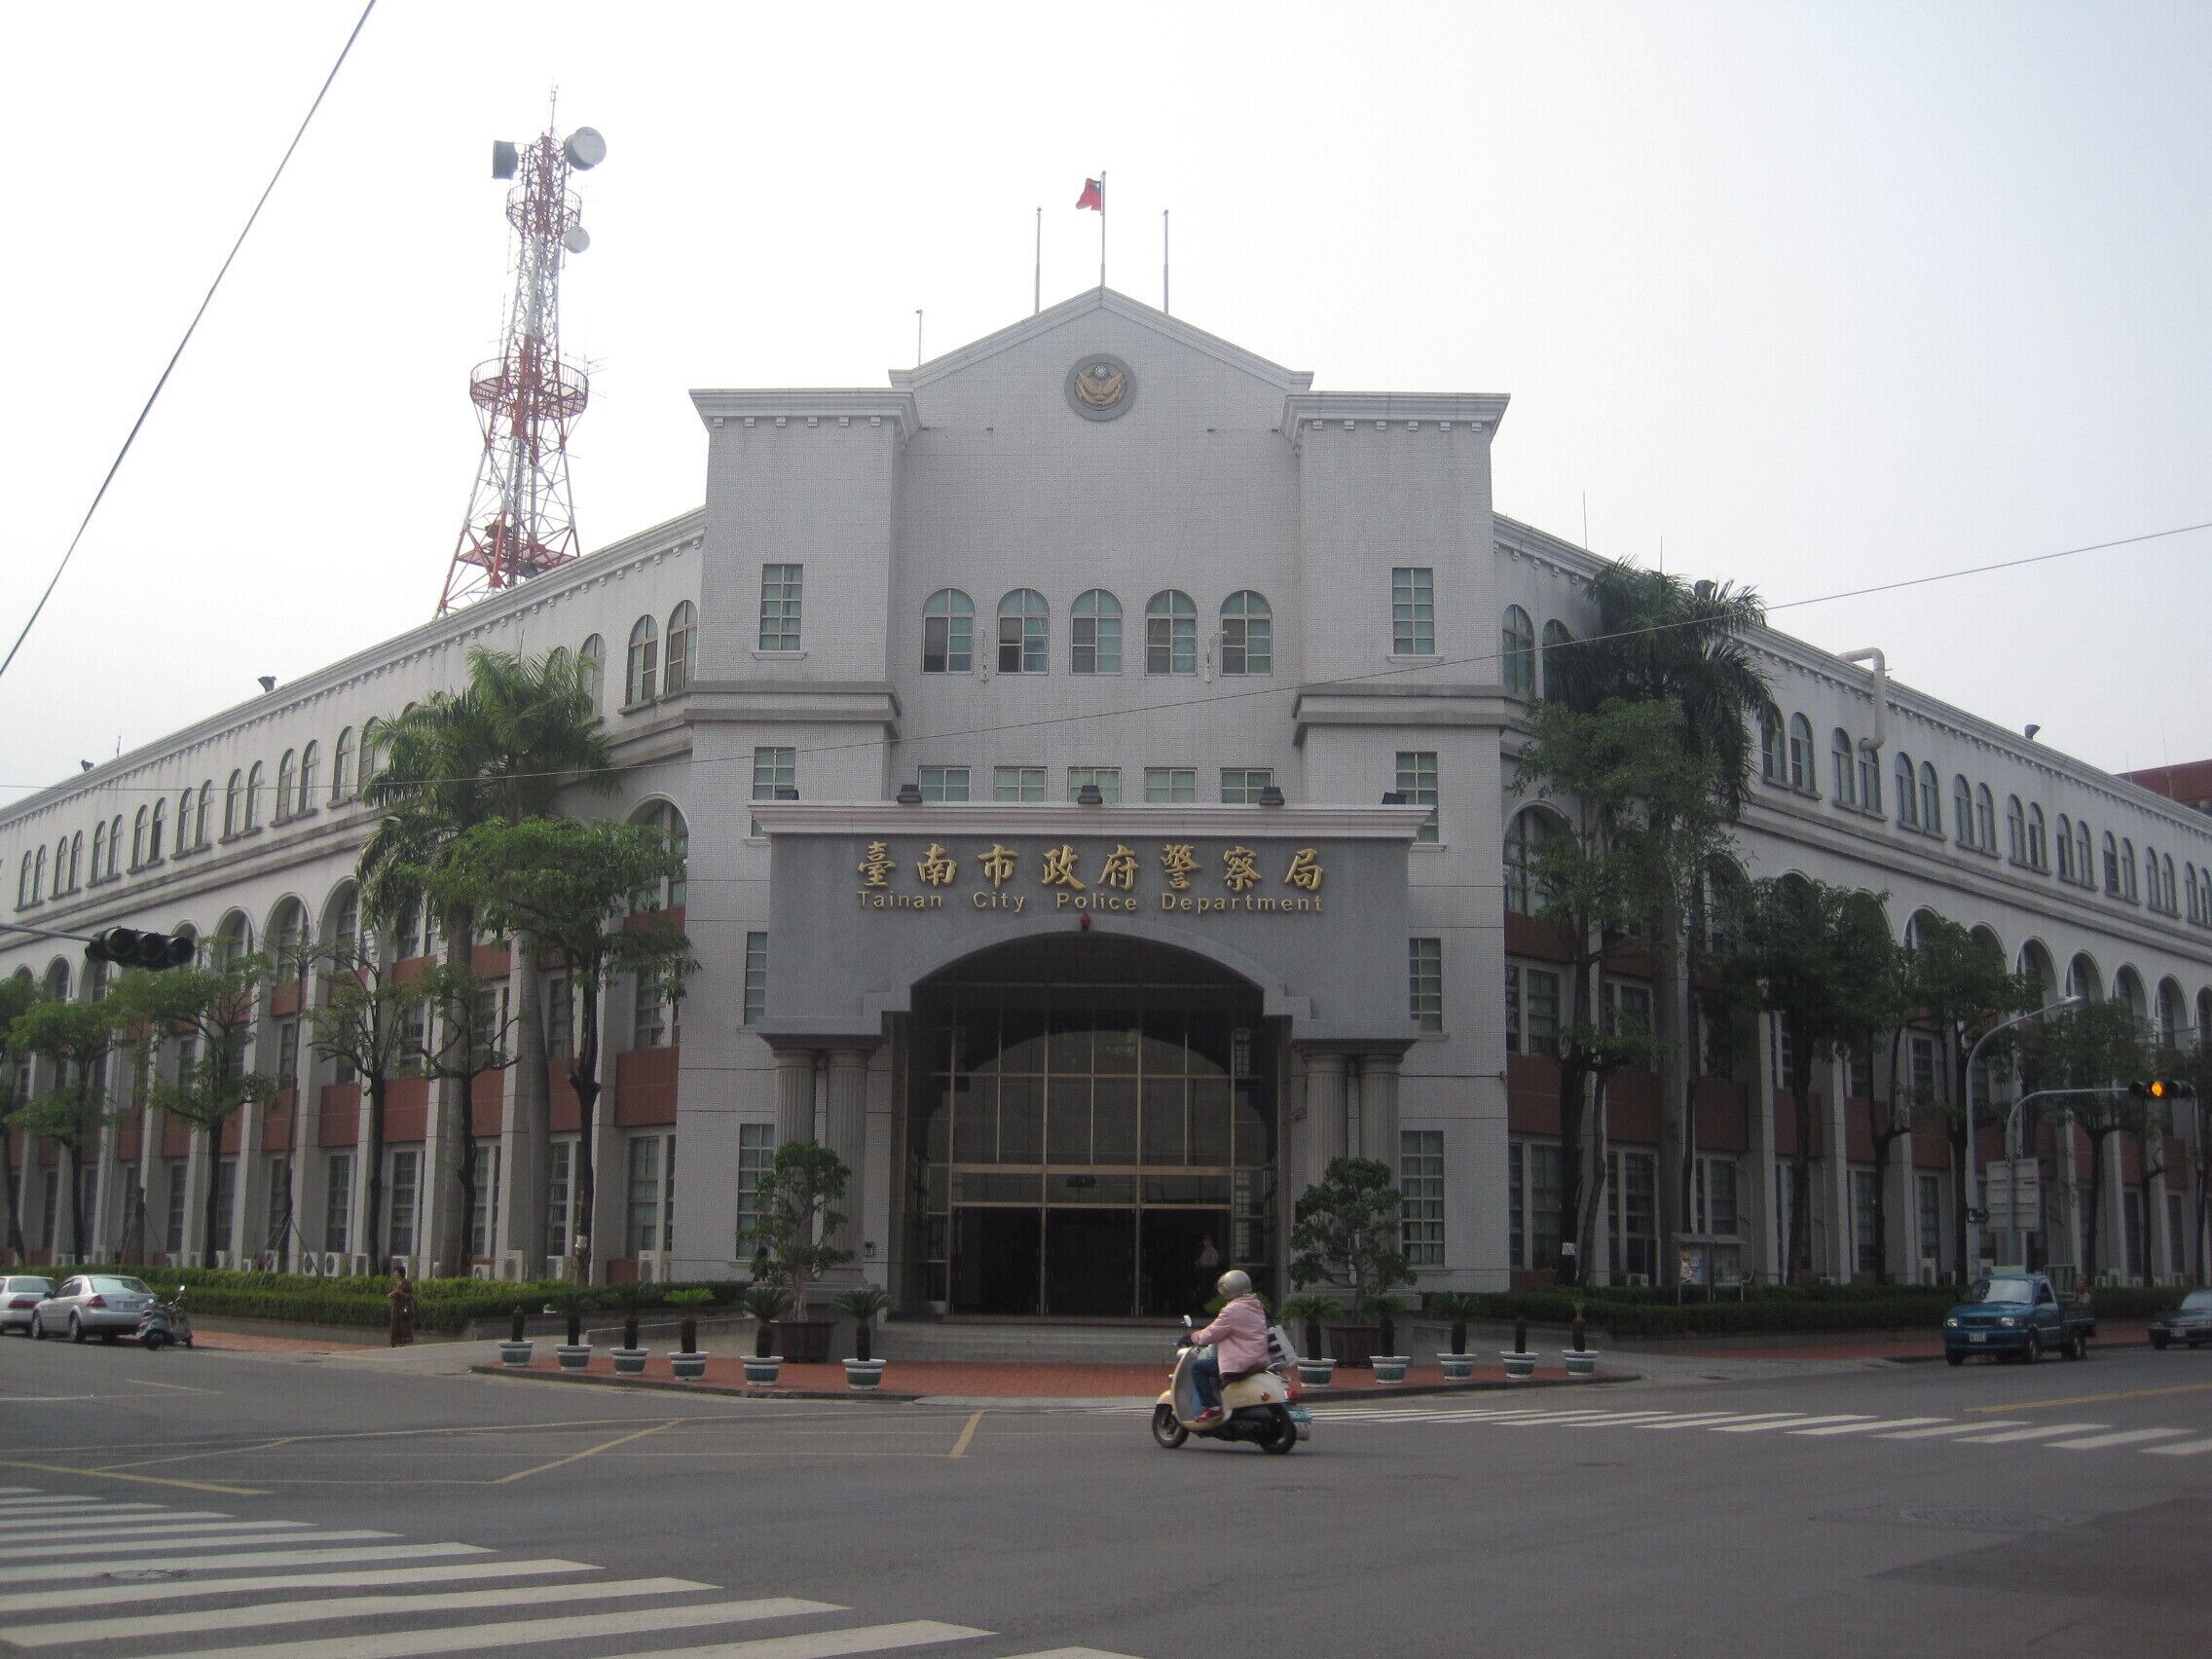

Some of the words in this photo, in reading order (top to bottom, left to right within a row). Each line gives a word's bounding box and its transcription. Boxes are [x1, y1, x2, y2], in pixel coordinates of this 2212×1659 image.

[857, 840, 1324, 892] 臺南市政府警察局
[857, 891, 942, 909] Tainan
[973, 892, 1025, 912] City
[1056, 892, 1138, 911] Police
[1161, 893, 1324, 914] Department
